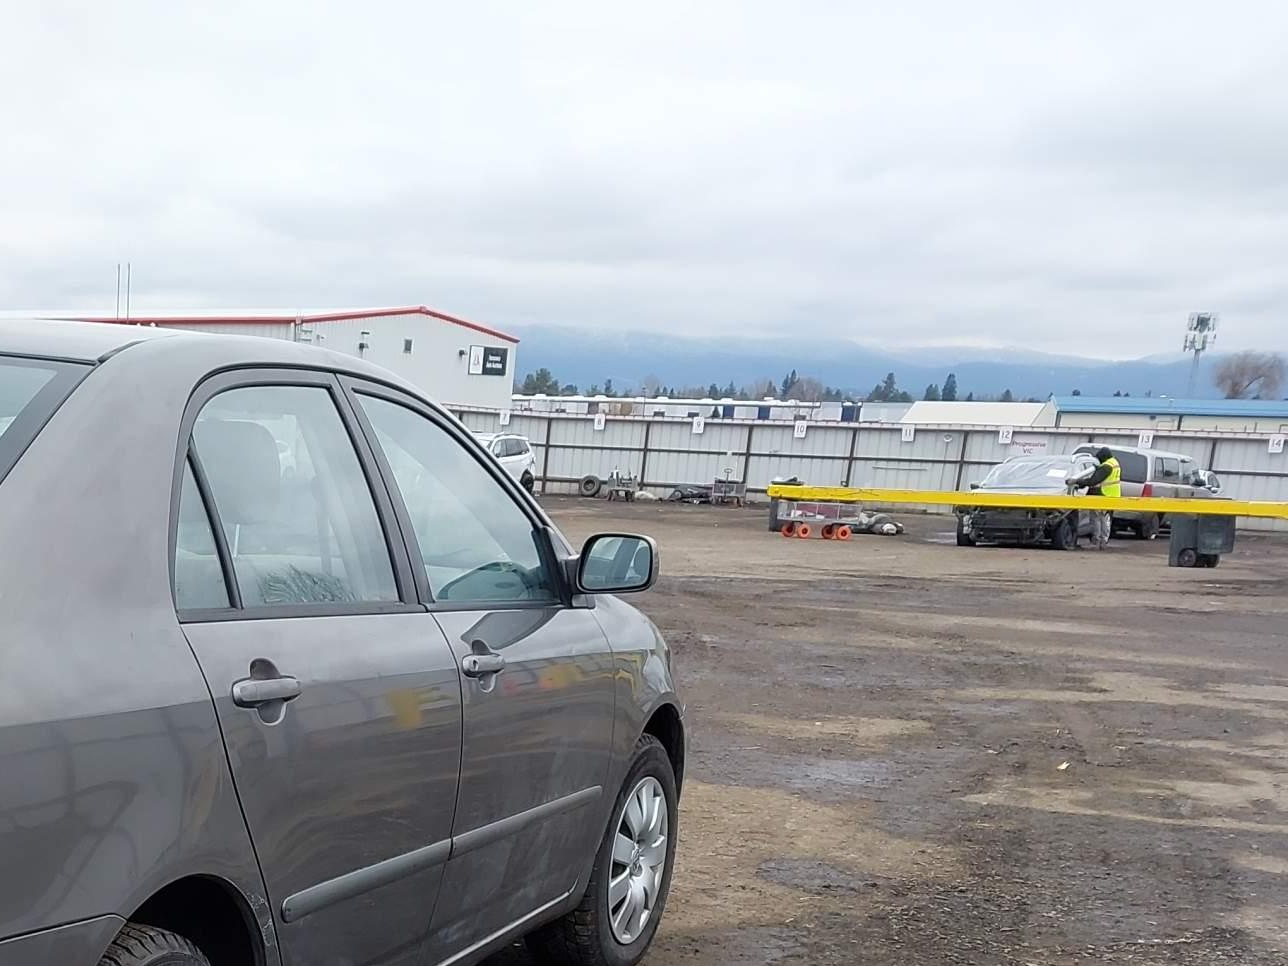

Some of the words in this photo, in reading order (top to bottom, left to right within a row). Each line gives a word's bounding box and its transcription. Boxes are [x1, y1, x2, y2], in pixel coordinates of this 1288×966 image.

[796, 425, 805, 433] 10
[1001, 430, 1011, 439] 12
[1141, 435, 1150, 444] 13
[1271, 438, 1282, 448] 14
